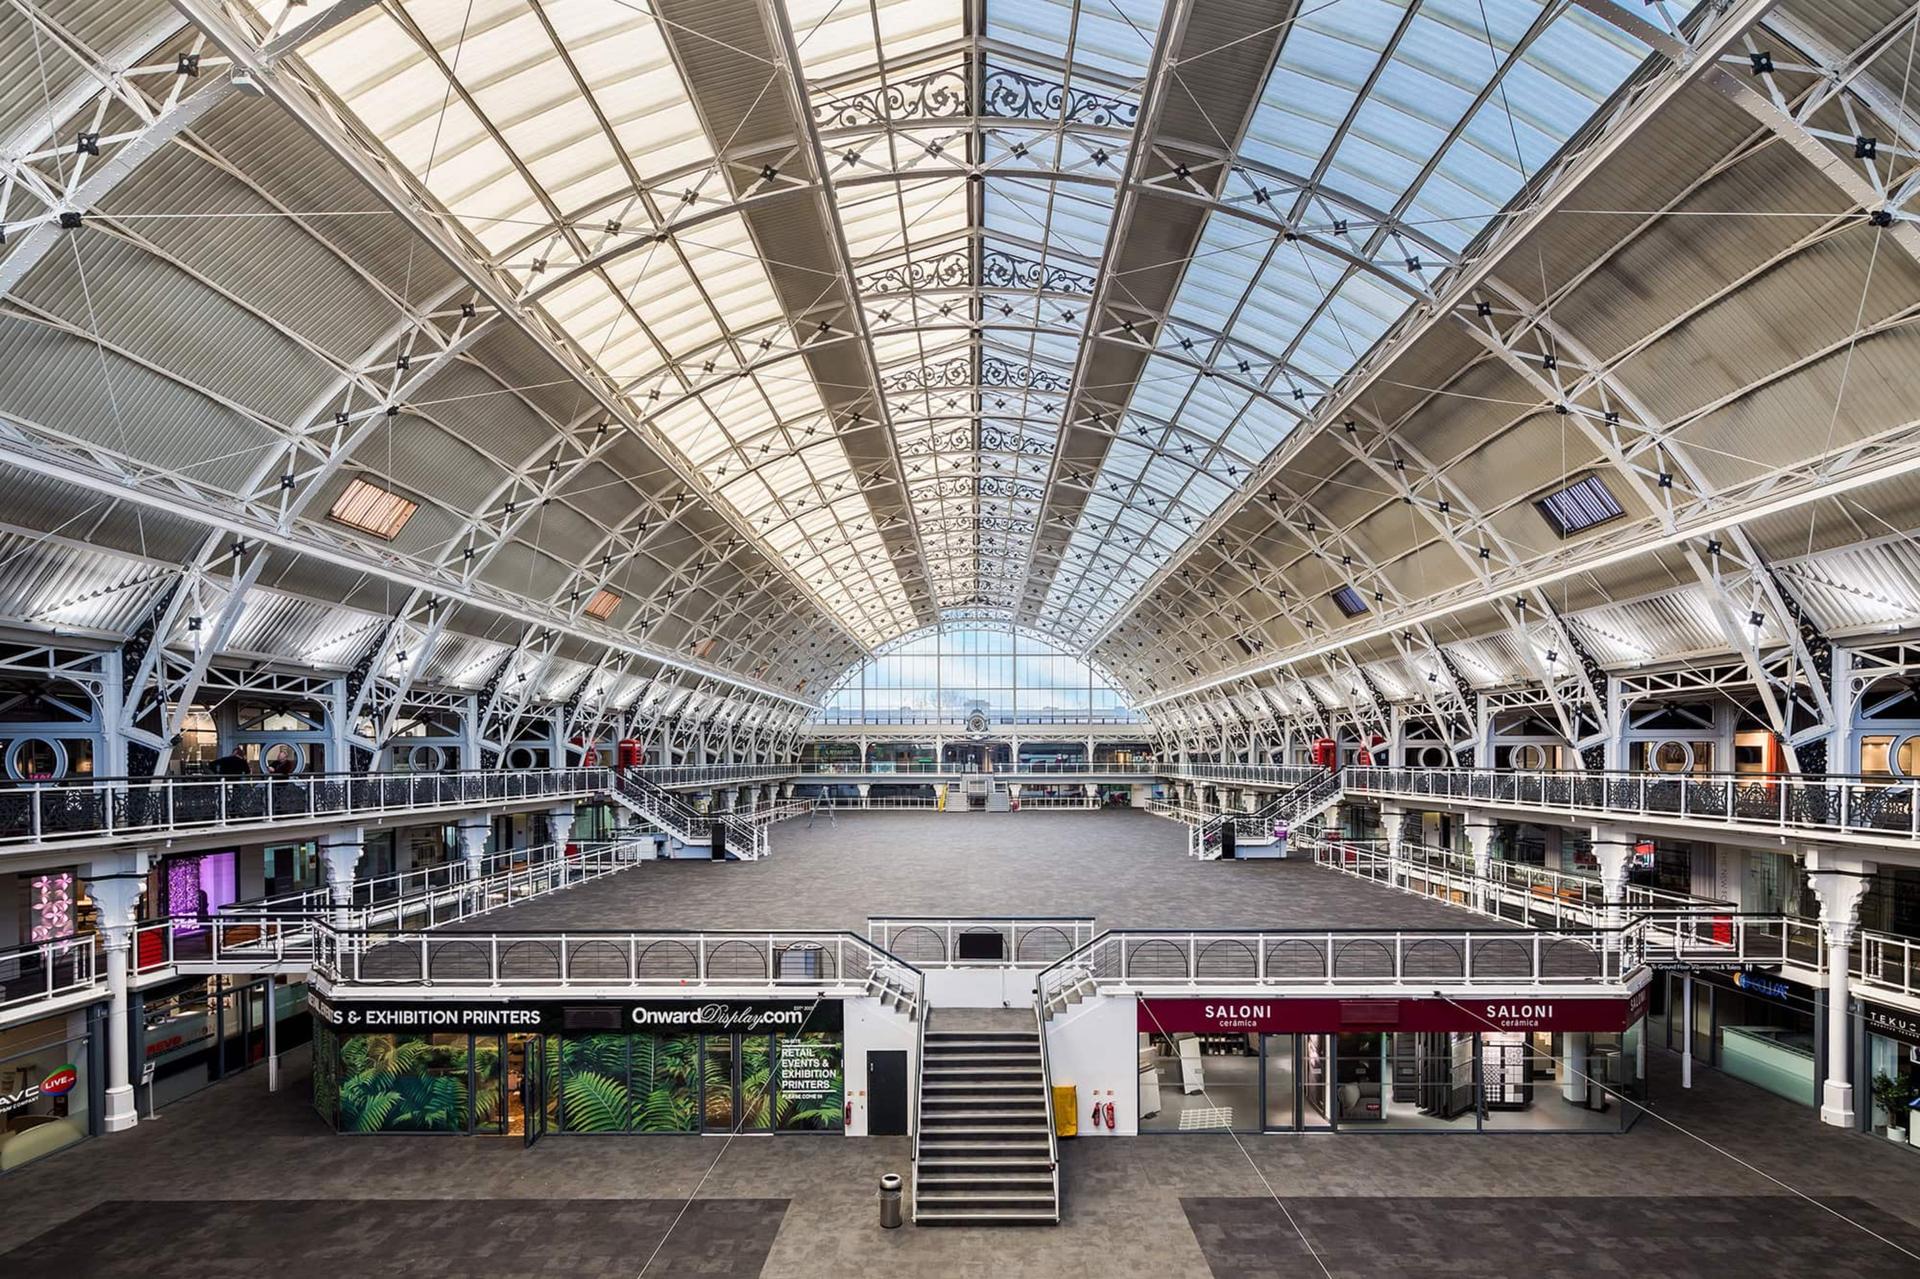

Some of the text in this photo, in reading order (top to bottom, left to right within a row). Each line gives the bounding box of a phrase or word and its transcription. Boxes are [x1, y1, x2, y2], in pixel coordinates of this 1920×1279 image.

[348, 1010, 362, 1024] &
[366, 1010, 458, 1024] EXHIBITION
[463, 1010, 541, 1024] PRINTERS
[1205, 1005, 1271, 1018] SALONI
[1486, 1005, 1553, 1018] SALONI
[781, 1048, 816, 1057] RETAIL
[781, 1059, 830, 1068] EVENTS &
[781, 1069, 836, 1078] EXHIBITION
[45, 1076, 68, 1089] LIVE
[781, 1080, 830, 1089] PRINTERS
